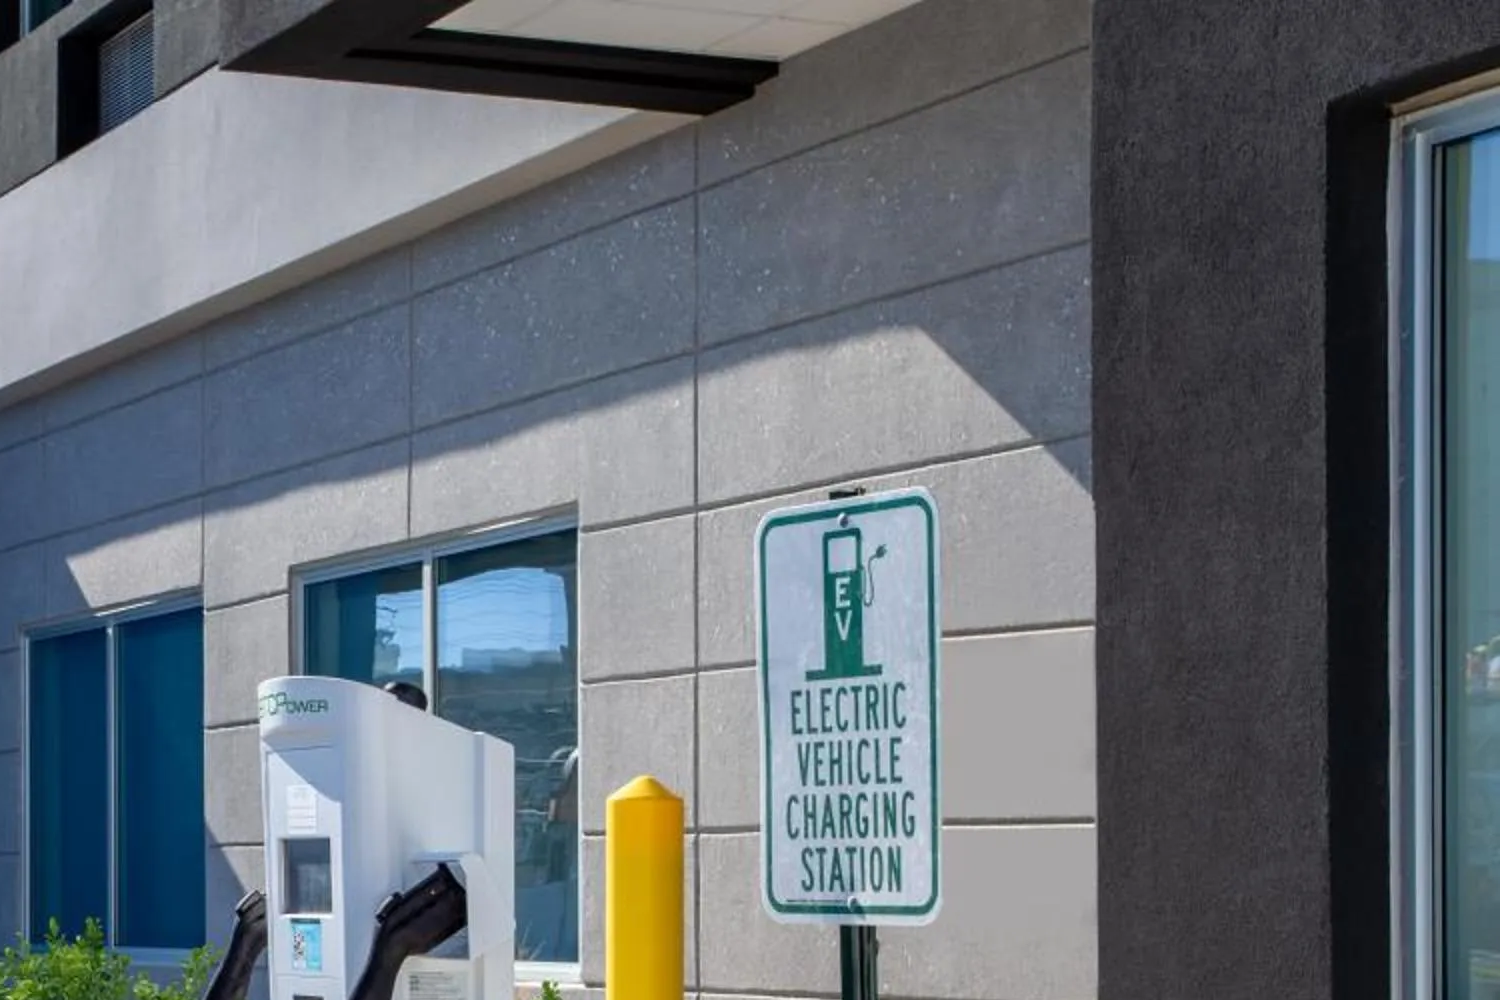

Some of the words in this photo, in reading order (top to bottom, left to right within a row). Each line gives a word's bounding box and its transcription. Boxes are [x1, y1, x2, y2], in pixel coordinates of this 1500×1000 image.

[834, 577, 852, 641] EV
[791, 682, 906, 735] ELECTRIC
[798, 736, 903, 786] VEHICLE
[786, 790, 915, 840] CHARGING
[801, 846, 902, 892] STATION
